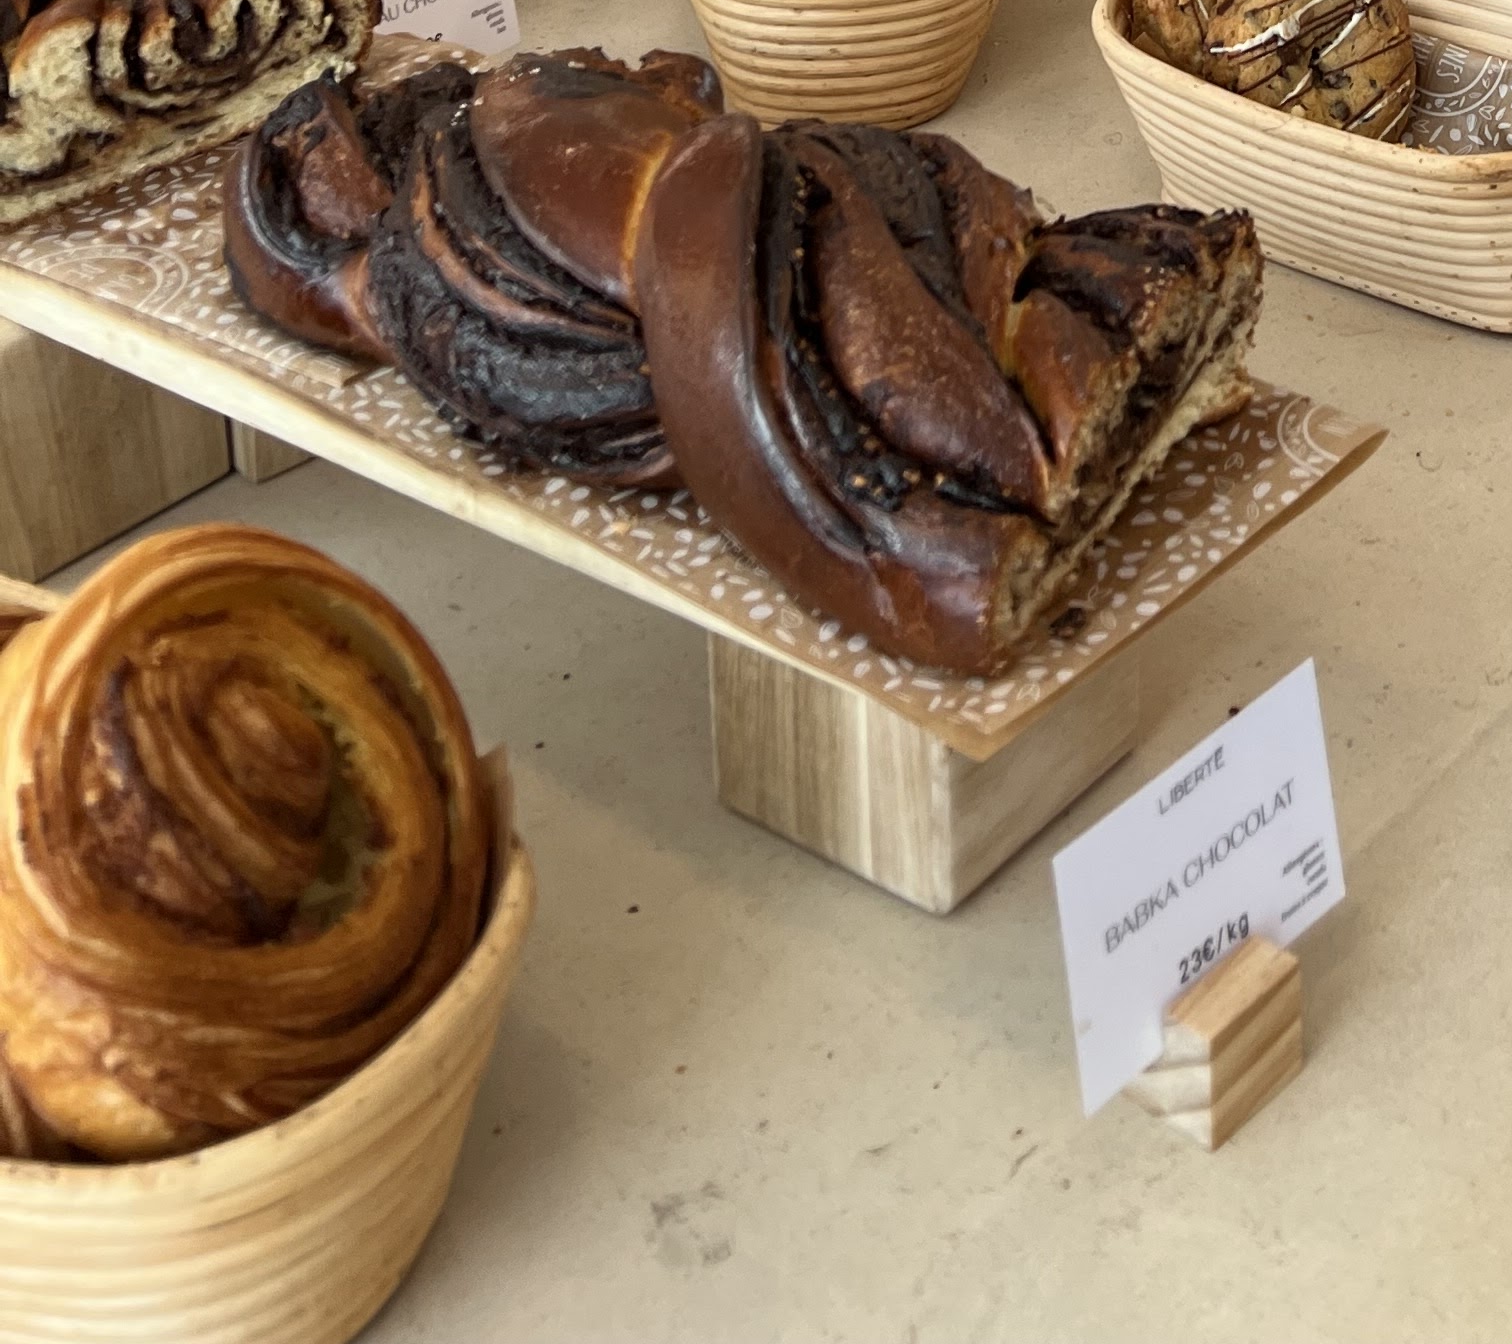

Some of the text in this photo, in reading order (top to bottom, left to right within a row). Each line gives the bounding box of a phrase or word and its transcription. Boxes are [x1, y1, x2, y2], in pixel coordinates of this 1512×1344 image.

[1104, 878, 1179, 955] BABKA
[1183, 777, 1297, 889] CHOCOLAT
[1178, 912, 1250, 985] 23€/kg
